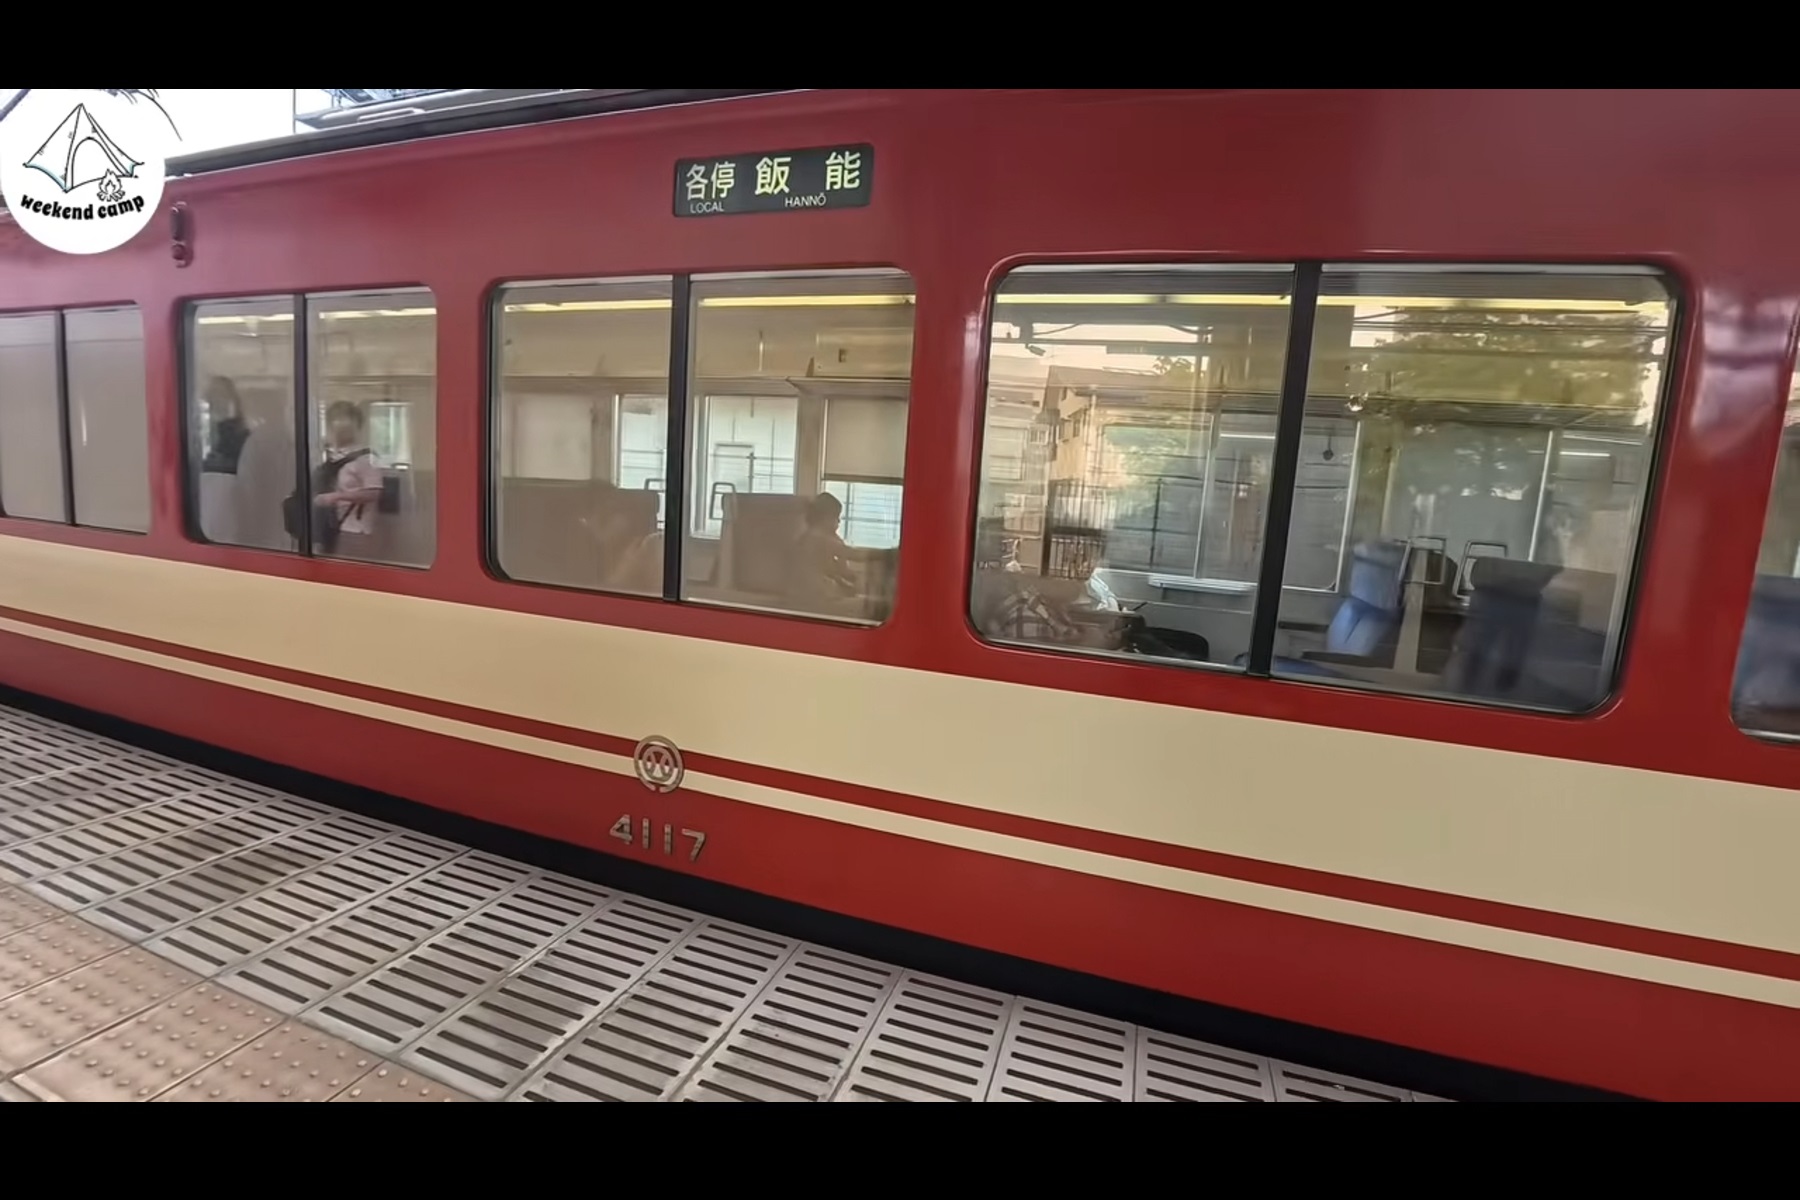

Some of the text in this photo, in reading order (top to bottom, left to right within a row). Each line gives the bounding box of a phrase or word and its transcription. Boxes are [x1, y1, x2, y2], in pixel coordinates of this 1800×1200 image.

[686, 151, 861, 201] 各停 飯能
[690, 202, 725, 214] LOCAL
[609, 814, 706, 862] 4117
